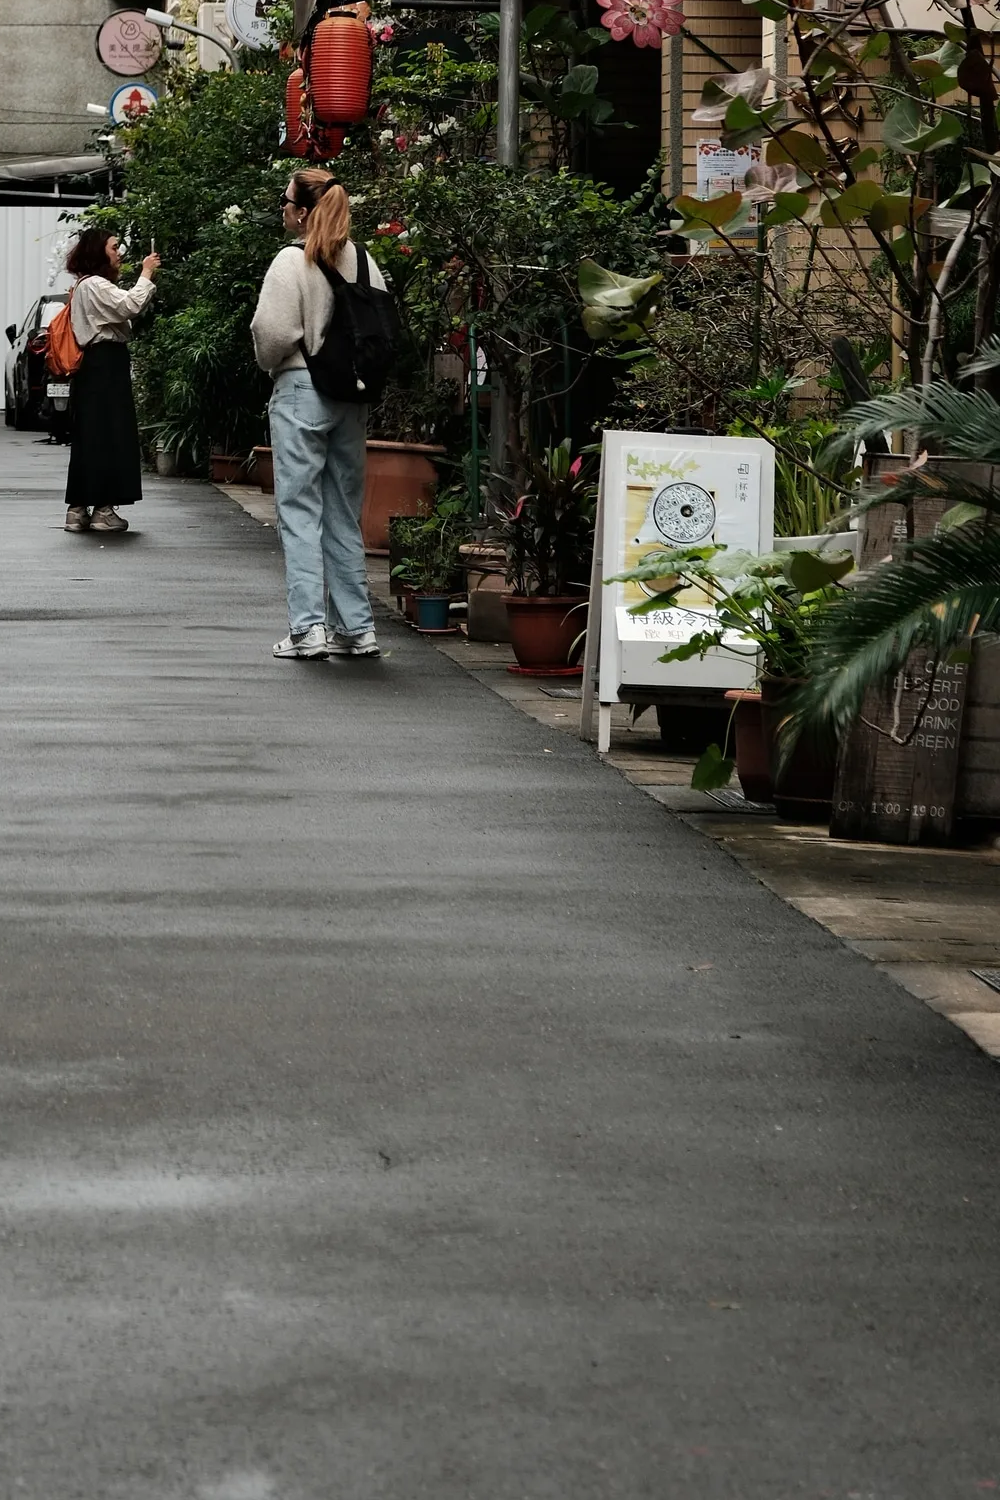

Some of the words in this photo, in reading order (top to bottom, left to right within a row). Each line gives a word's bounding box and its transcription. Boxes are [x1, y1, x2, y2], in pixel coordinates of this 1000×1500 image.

[925, 660, 965, 676] CAFE
[917, 698, 960, 712] FOOD
[913, 716, 957, 731] DRINK
